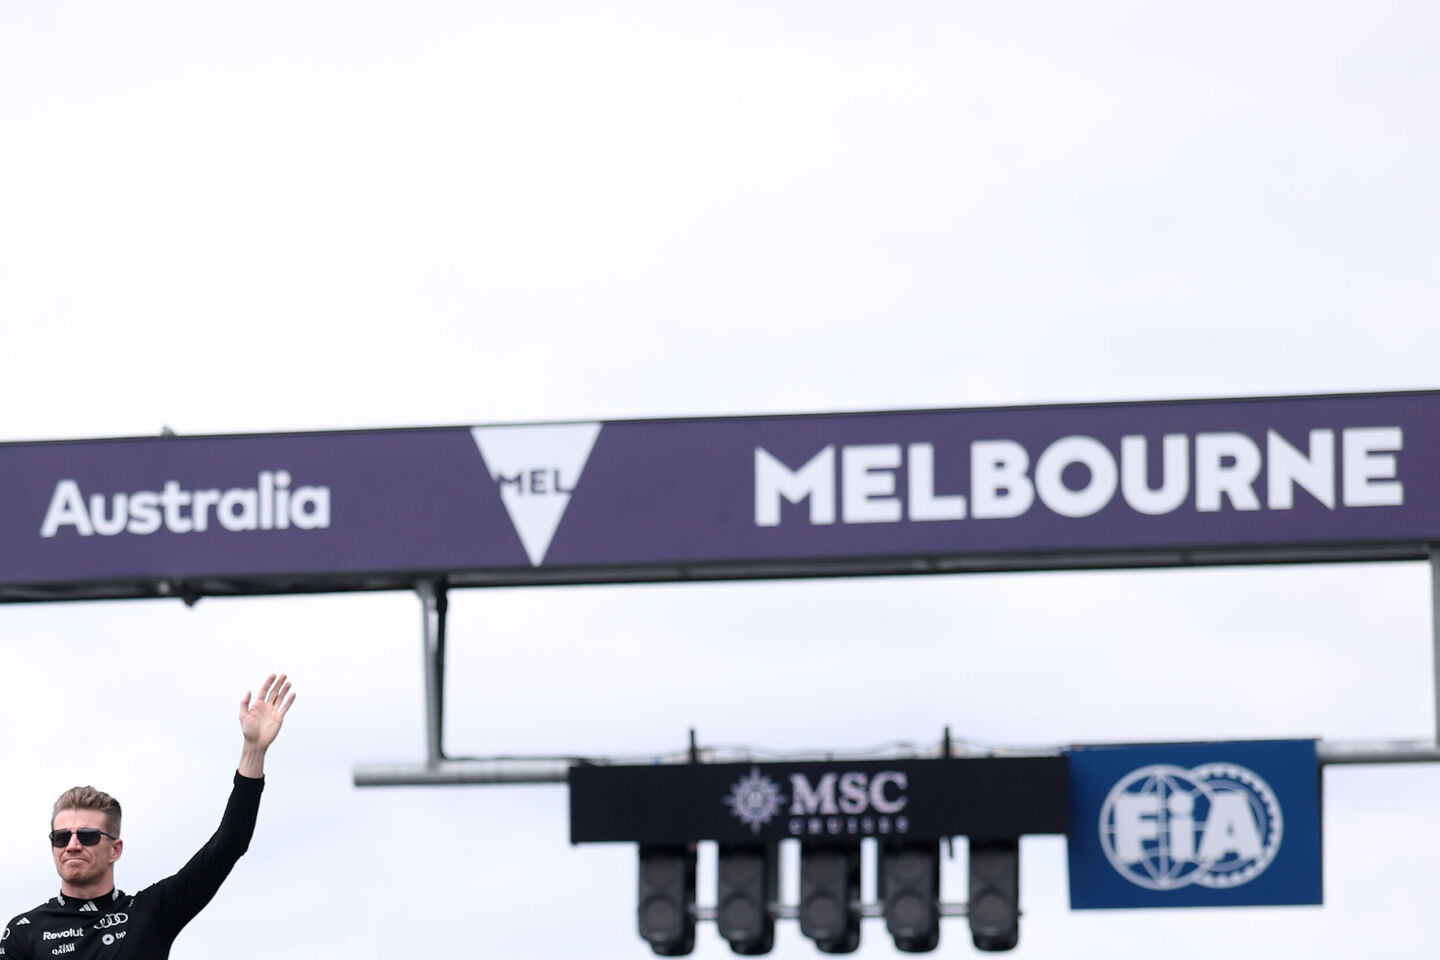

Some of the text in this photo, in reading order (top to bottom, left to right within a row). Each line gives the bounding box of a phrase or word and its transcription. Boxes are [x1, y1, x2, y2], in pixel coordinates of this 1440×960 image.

[495, 468, 574, 494] MEL
[754, 426, 1404, 526] MELBOURNE
[39, 470, 330, 538] Australia
[788, 770, 908, 815] MSC
[43, 928, 84, 940] Revolut
